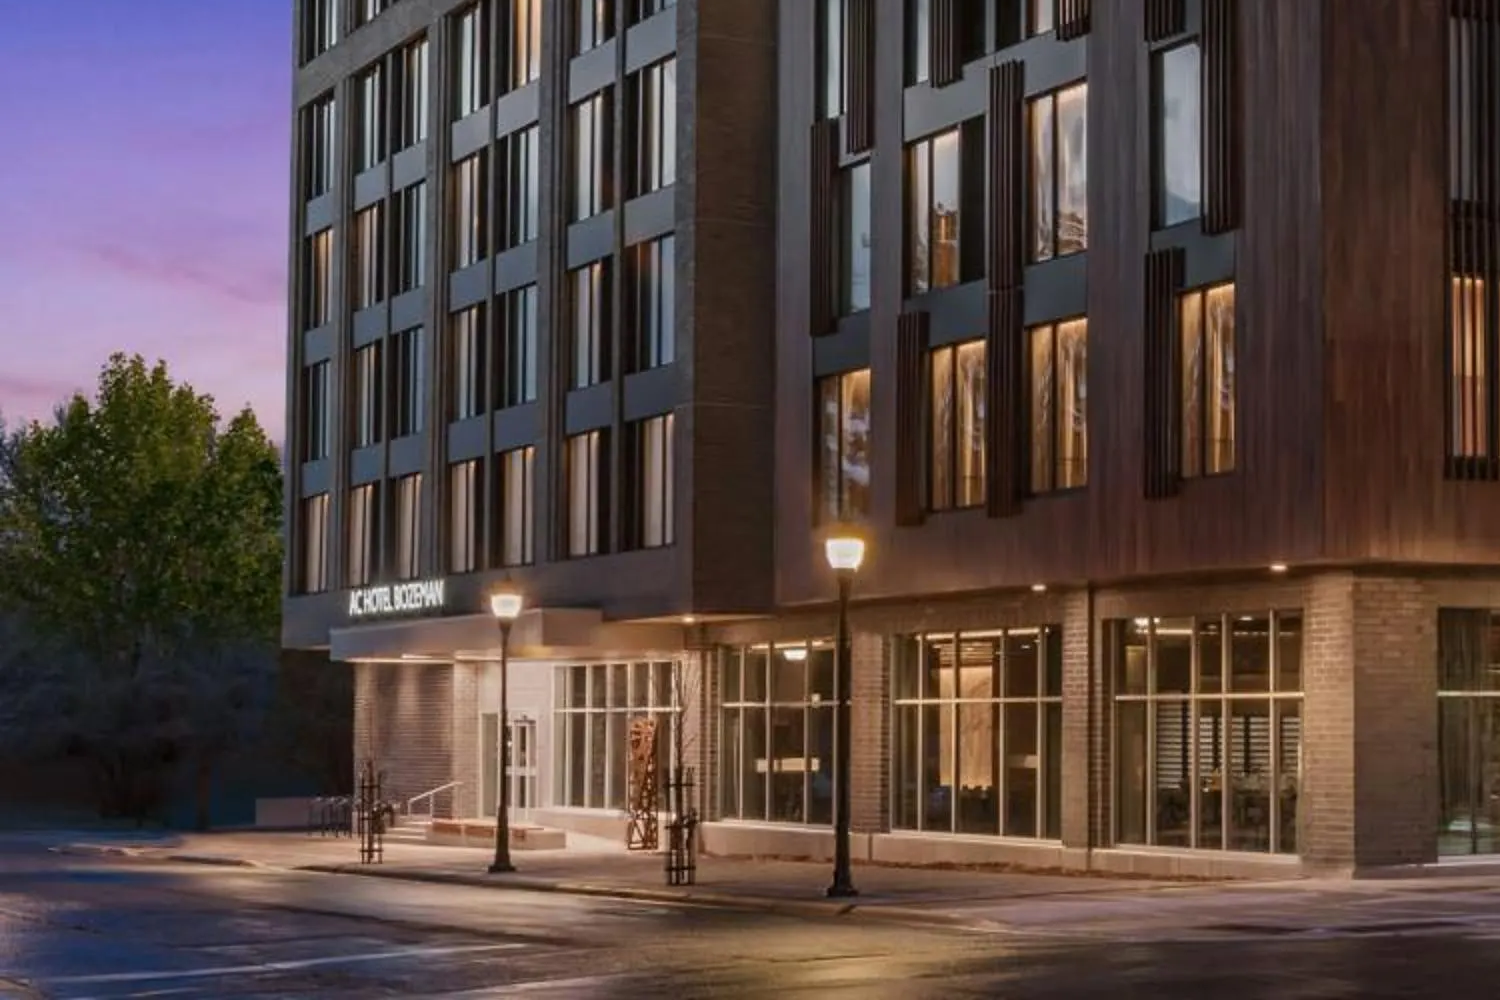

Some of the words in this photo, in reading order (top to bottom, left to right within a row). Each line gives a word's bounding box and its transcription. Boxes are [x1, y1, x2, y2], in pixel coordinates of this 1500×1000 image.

[349, 589, 363, 616] AC
[363, 586, 393, 614] HOTEL
[394, 579, 445, 611] BOZEMAN
